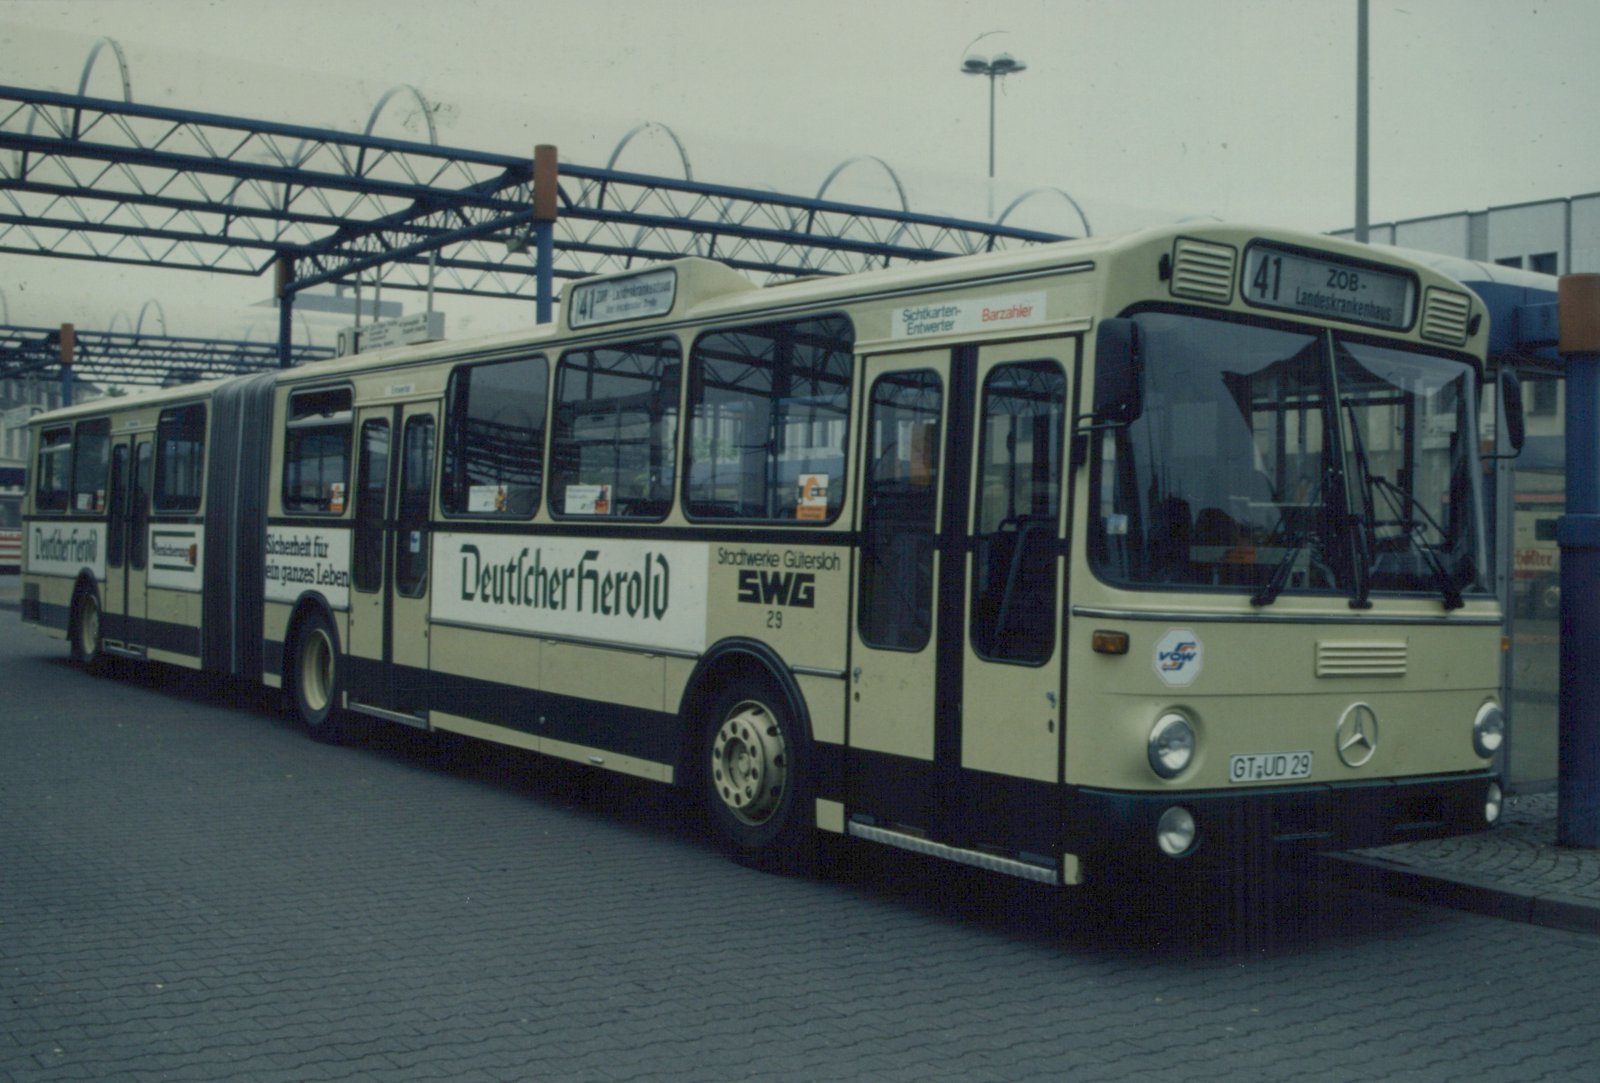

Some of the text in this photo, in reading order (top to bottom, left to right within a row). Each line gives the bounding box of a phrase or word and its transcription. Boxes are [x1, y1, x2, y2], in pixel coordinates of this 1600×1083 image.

[1253, 254, 1282, 301] 41
[576, 287, 595, 320] 41
[902, 304, 961, 323] Sichtkarten-
[981, 304, 1033, 323] Barzahler
[1295, 286, 1393, 322] Landeskrankenhaus
[906, 319, 955, 336] Entwerter
[266, 533, 329, 558] Sicherheit für
[717, 547, 841, 571] Stadtwerke Gütersloh
[281, 565, 315, 587] ganzes
[576, 549, 670, 621] Herold
[737, 569, 815, 608] SWG
[766, 610, 783, 629] 29
[1290, 754, 1310, 776] 29
